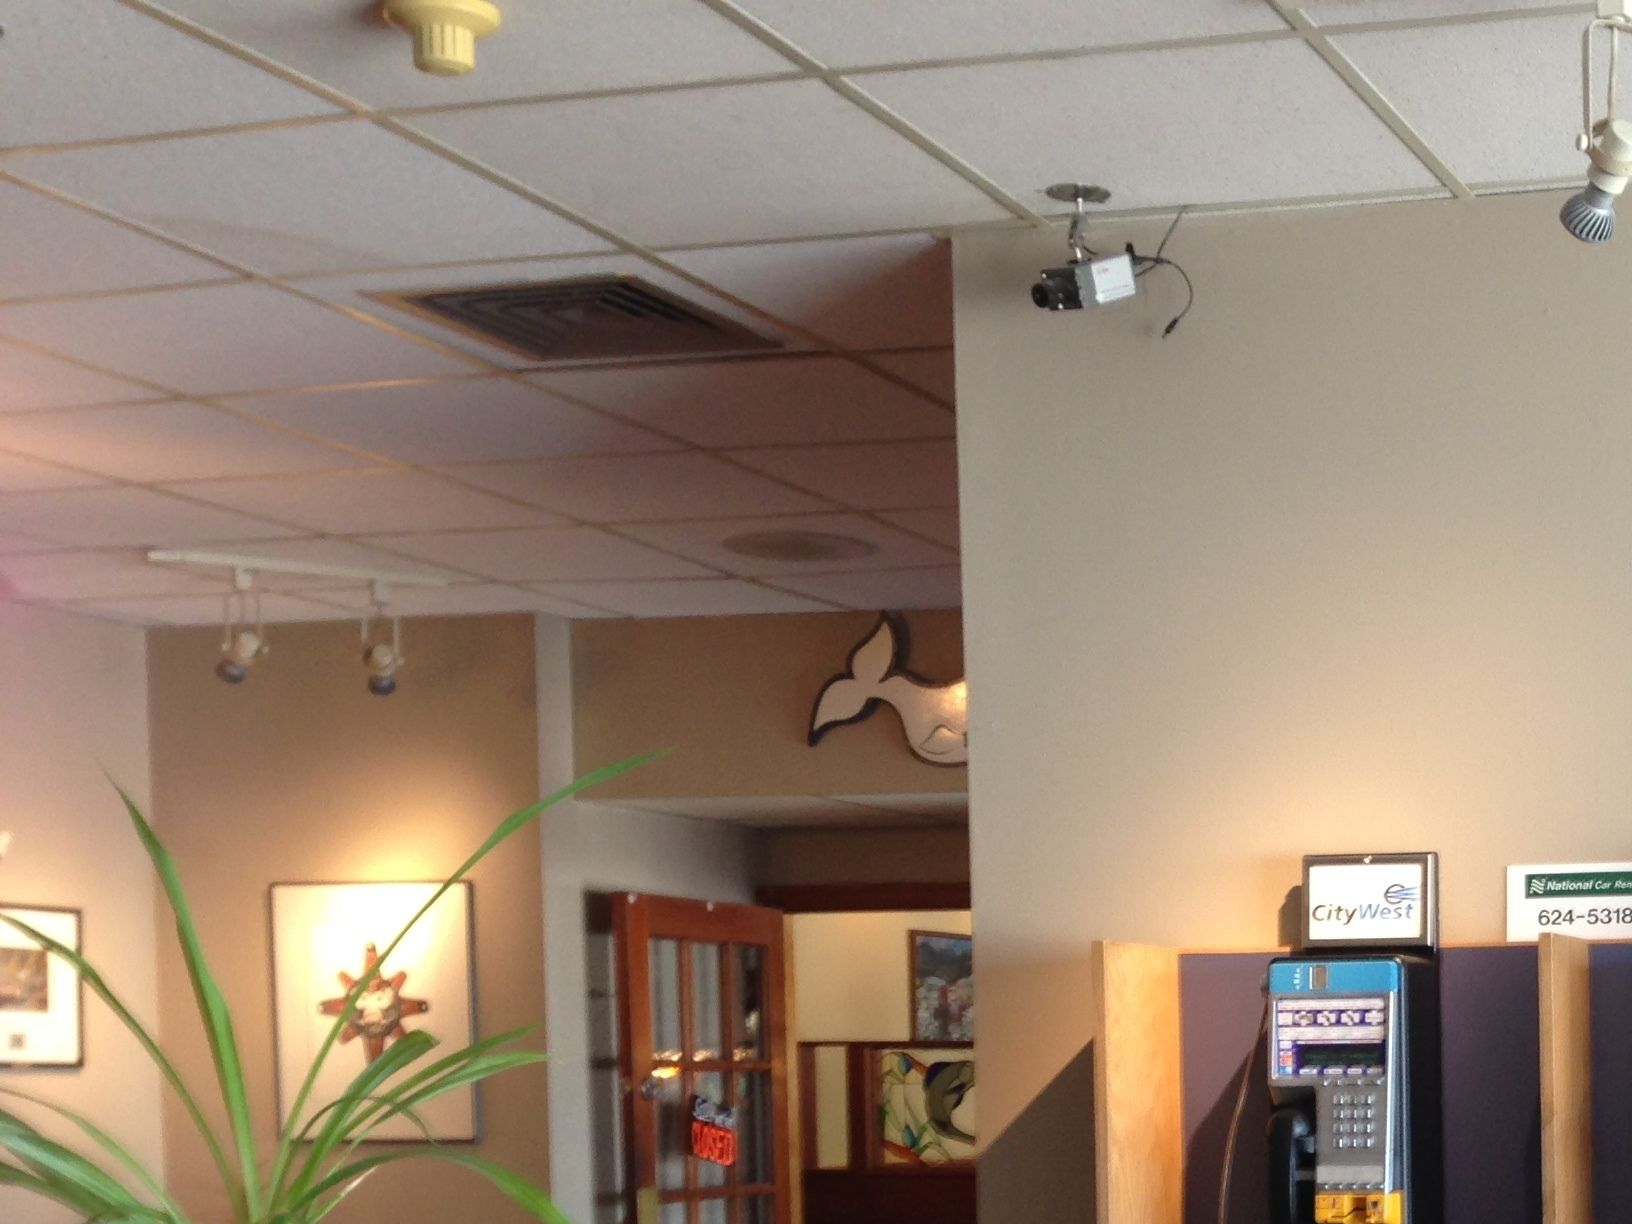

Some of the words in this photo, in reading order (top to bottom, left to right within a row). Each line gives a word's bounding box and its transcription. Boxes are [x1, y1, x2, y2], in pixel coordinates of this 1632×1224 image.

[1546, 879, 1593, 891] National
[1595, 880, 1611, 890] Car
[1312, 903, 1414, 925] CityWest
